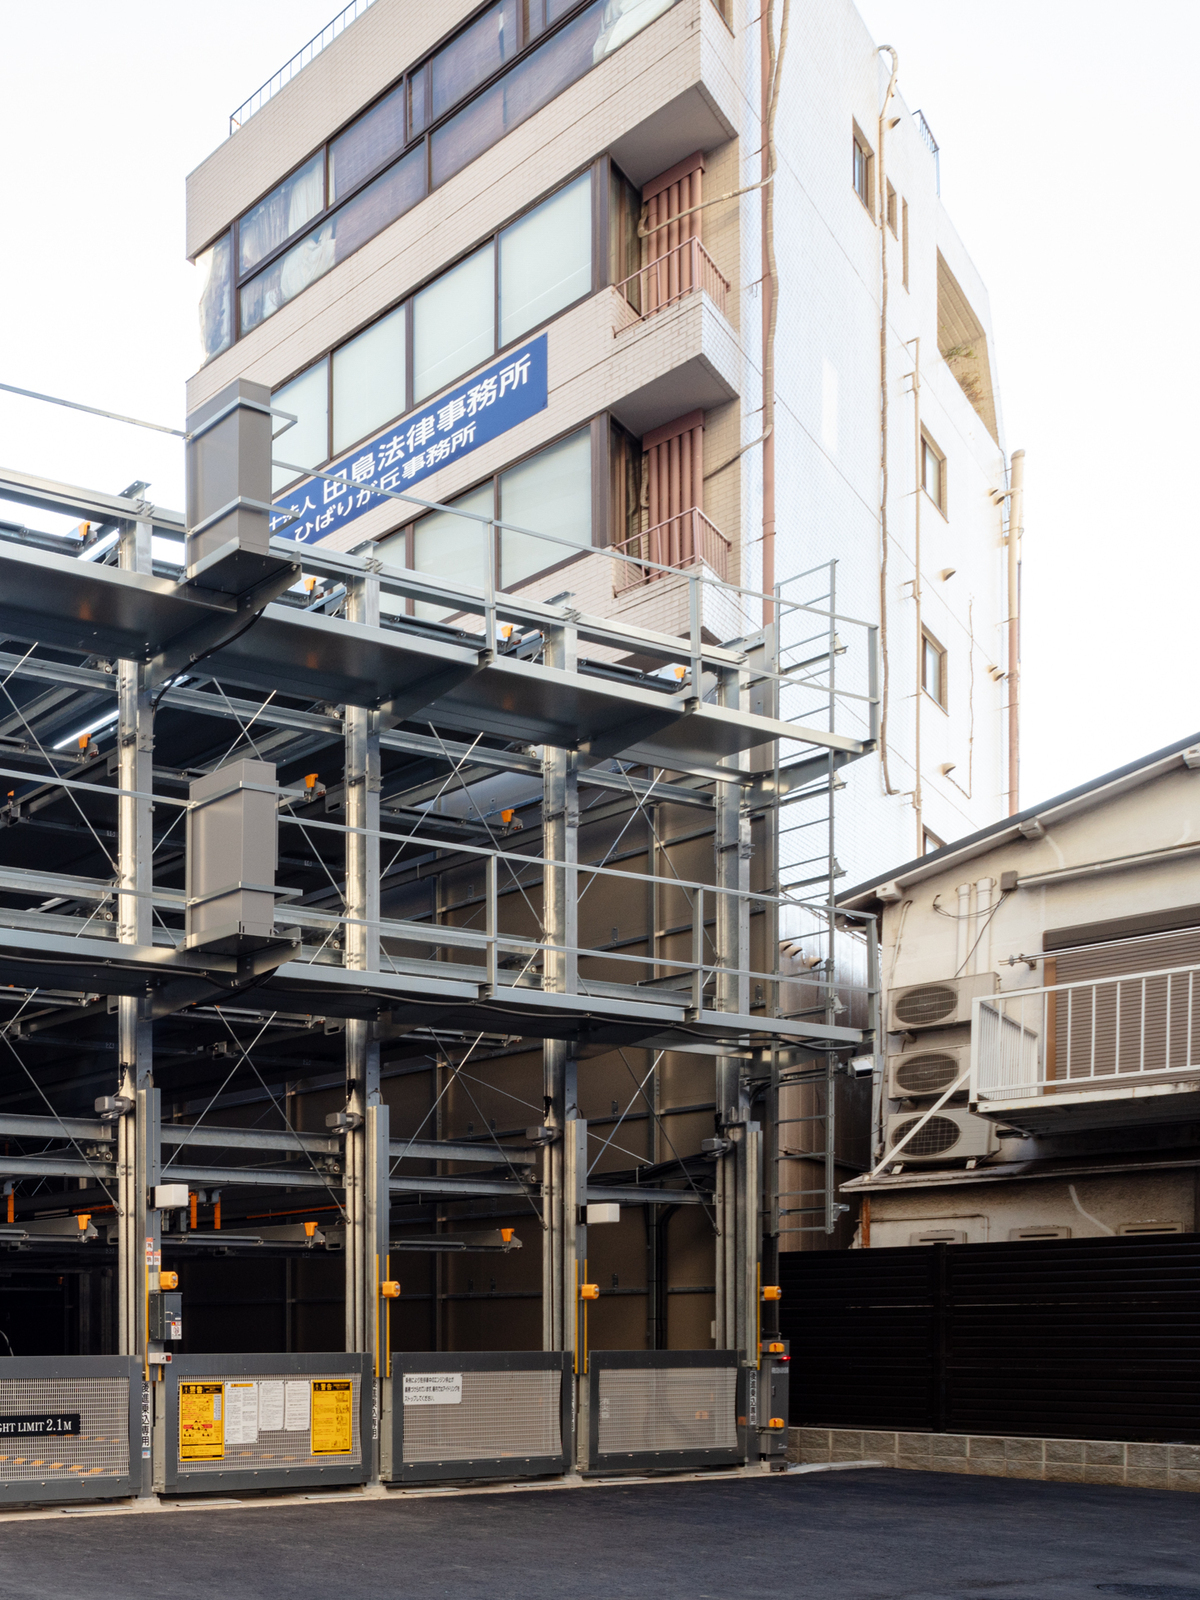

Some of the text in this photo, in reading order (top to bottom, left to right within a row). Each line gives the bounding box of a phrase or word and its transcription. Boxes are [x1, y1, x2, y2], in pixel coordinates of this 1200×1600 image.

[295, 421, 476, 542] ひばりが丘事務所
[323, 353, 531, 504] 田島法律事務所
[18, 1421, 45, 1432] LIMIT
